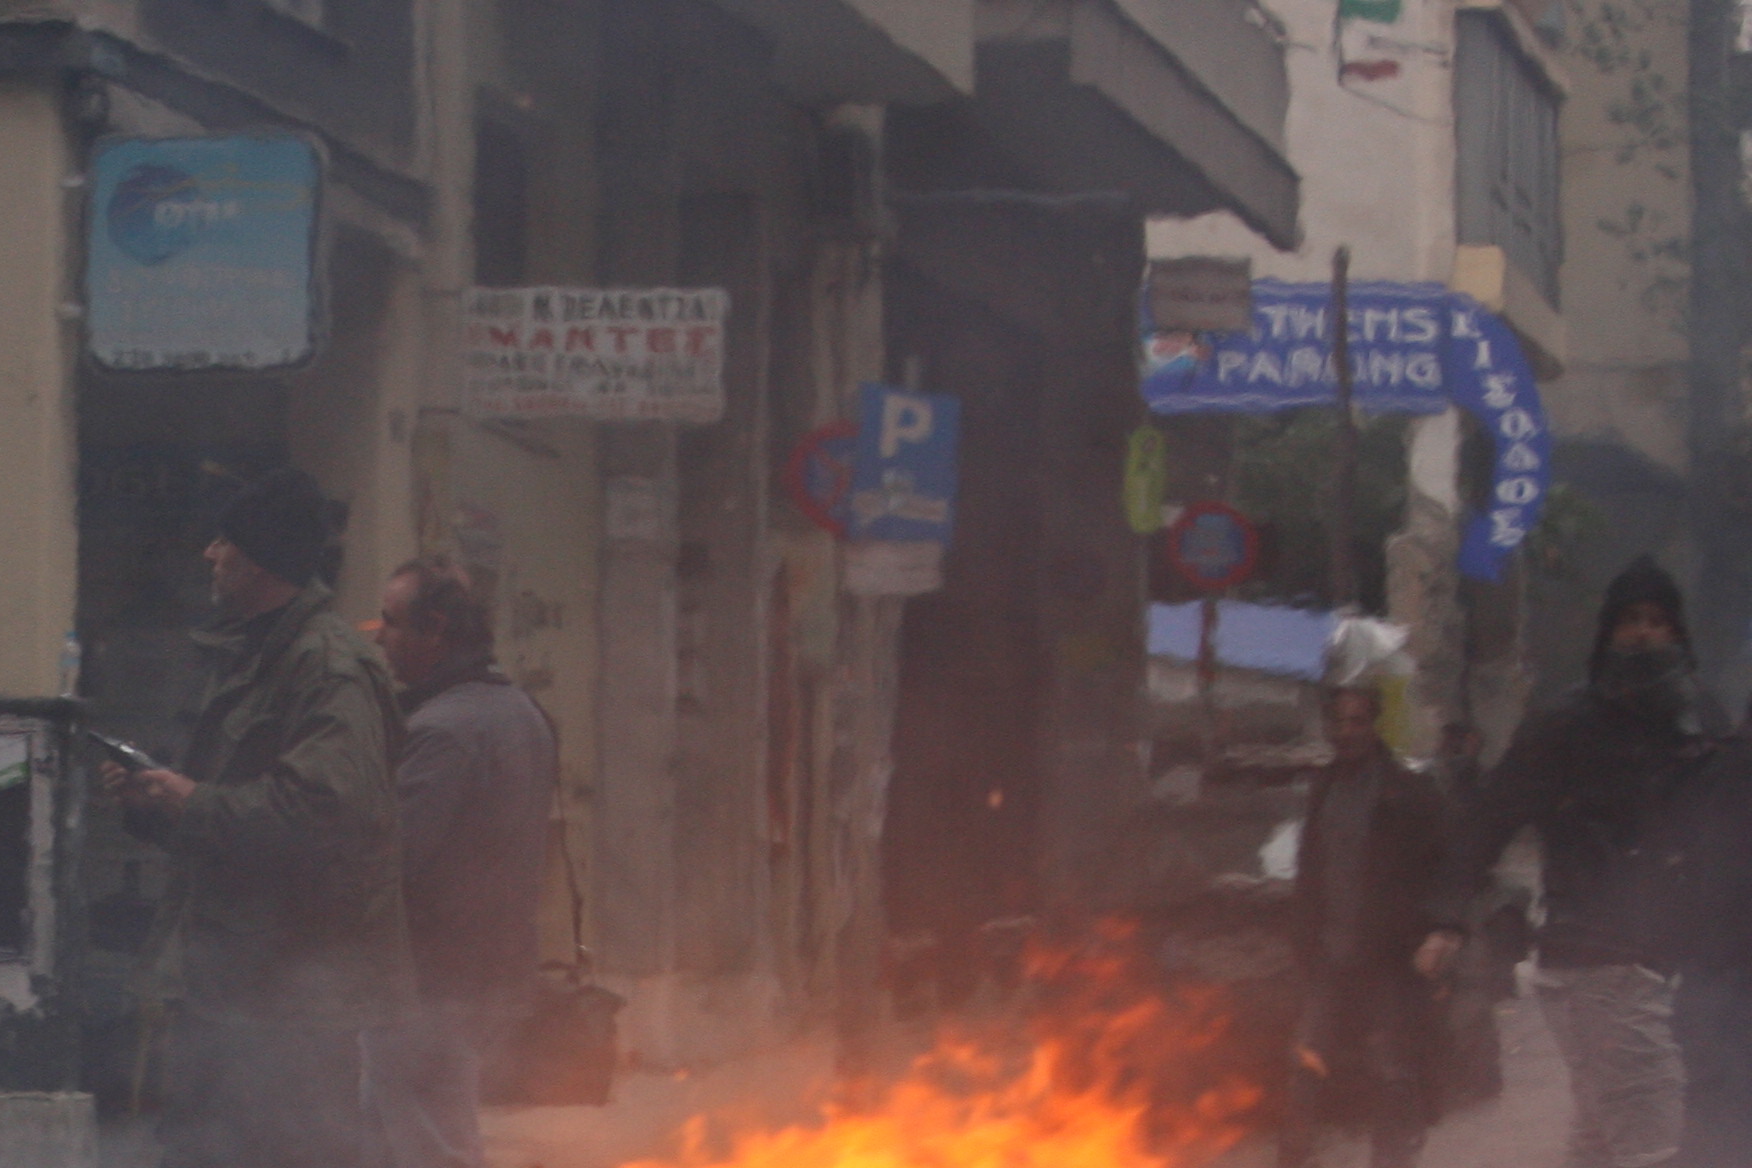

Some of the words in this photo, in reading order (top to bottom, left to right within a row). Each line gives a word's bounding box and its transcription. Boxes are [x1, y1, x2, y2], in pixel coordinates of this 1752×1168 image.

[1250, 304, 1438, 344] THNS
[1216, 349, 1443, 388] PARING
[878, 394, 934, 458] P
